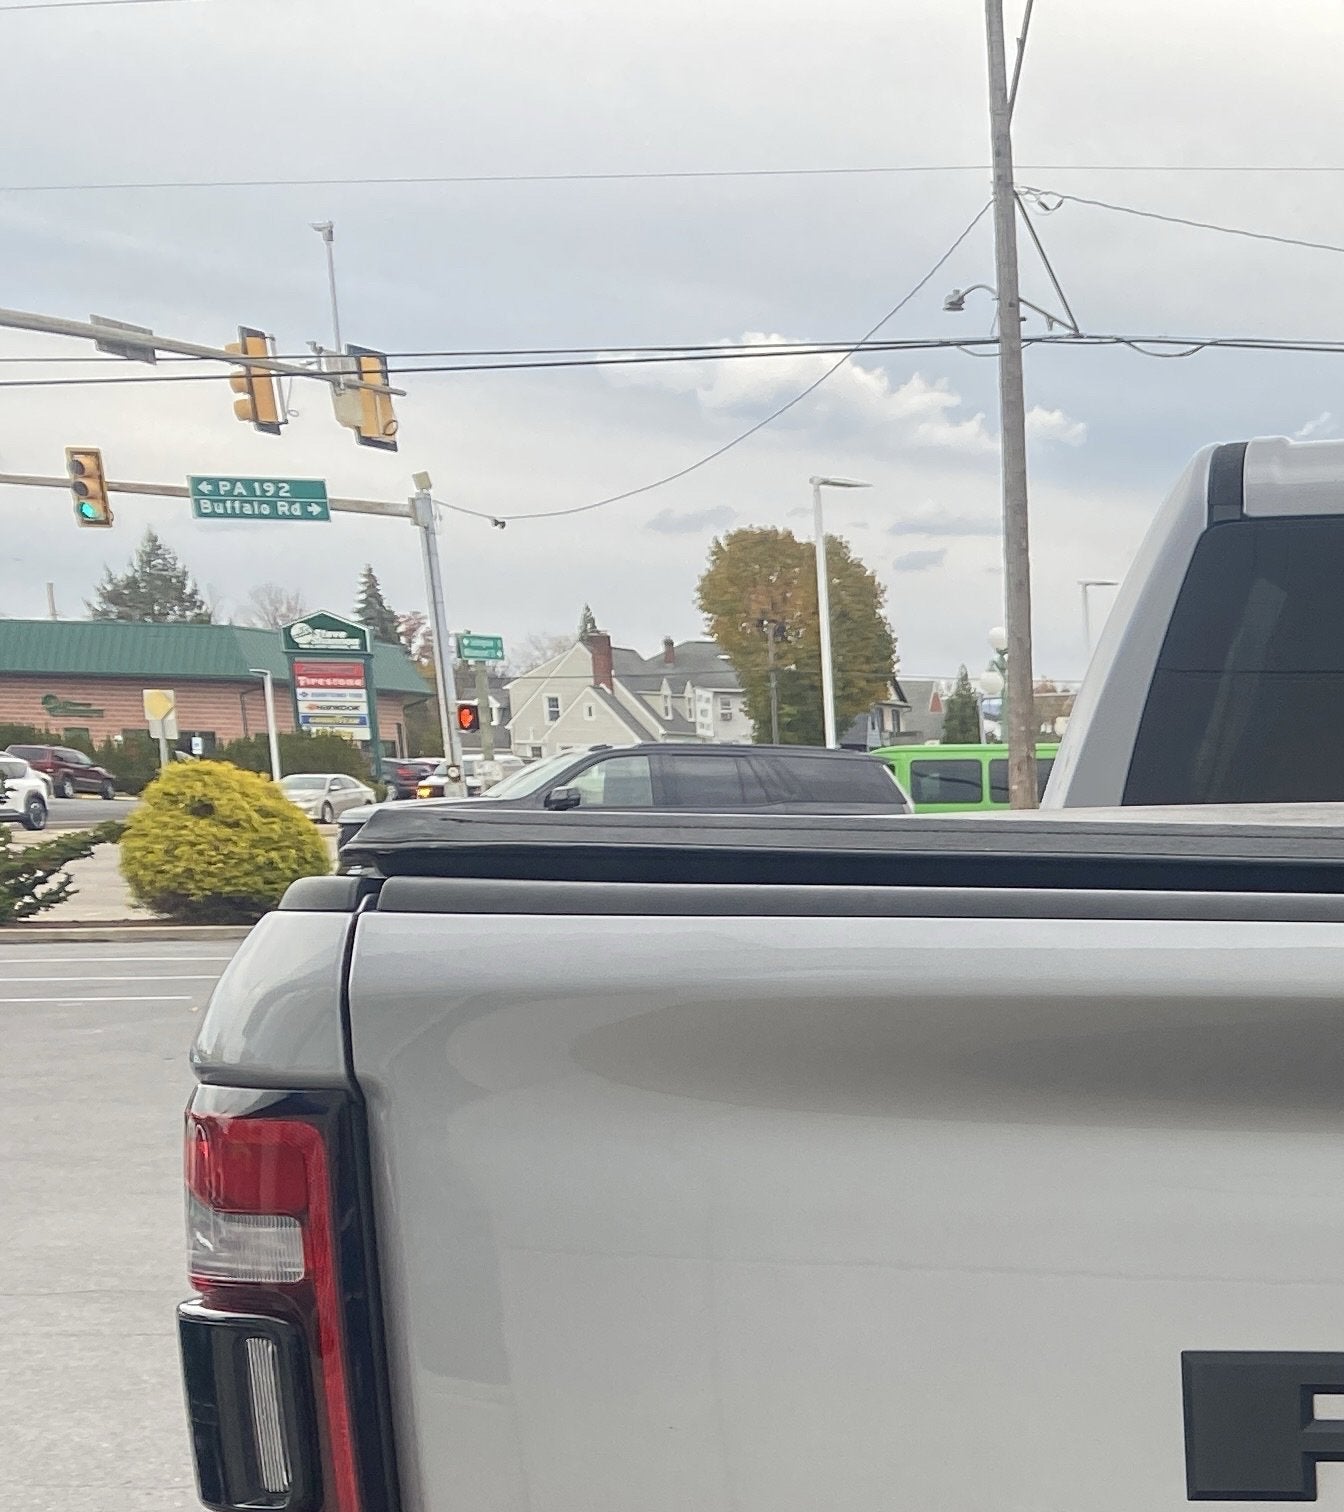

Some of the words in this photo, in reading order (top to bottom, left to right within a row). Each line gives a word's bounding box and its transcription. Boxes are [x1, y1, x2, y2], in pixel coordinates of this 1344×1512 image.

[218, 481, 247, 496] PA
[252, 482, 291, 497] 192
[200, 499, 271, 515] Buffalo
[277, 501, 302, 516] Rd
